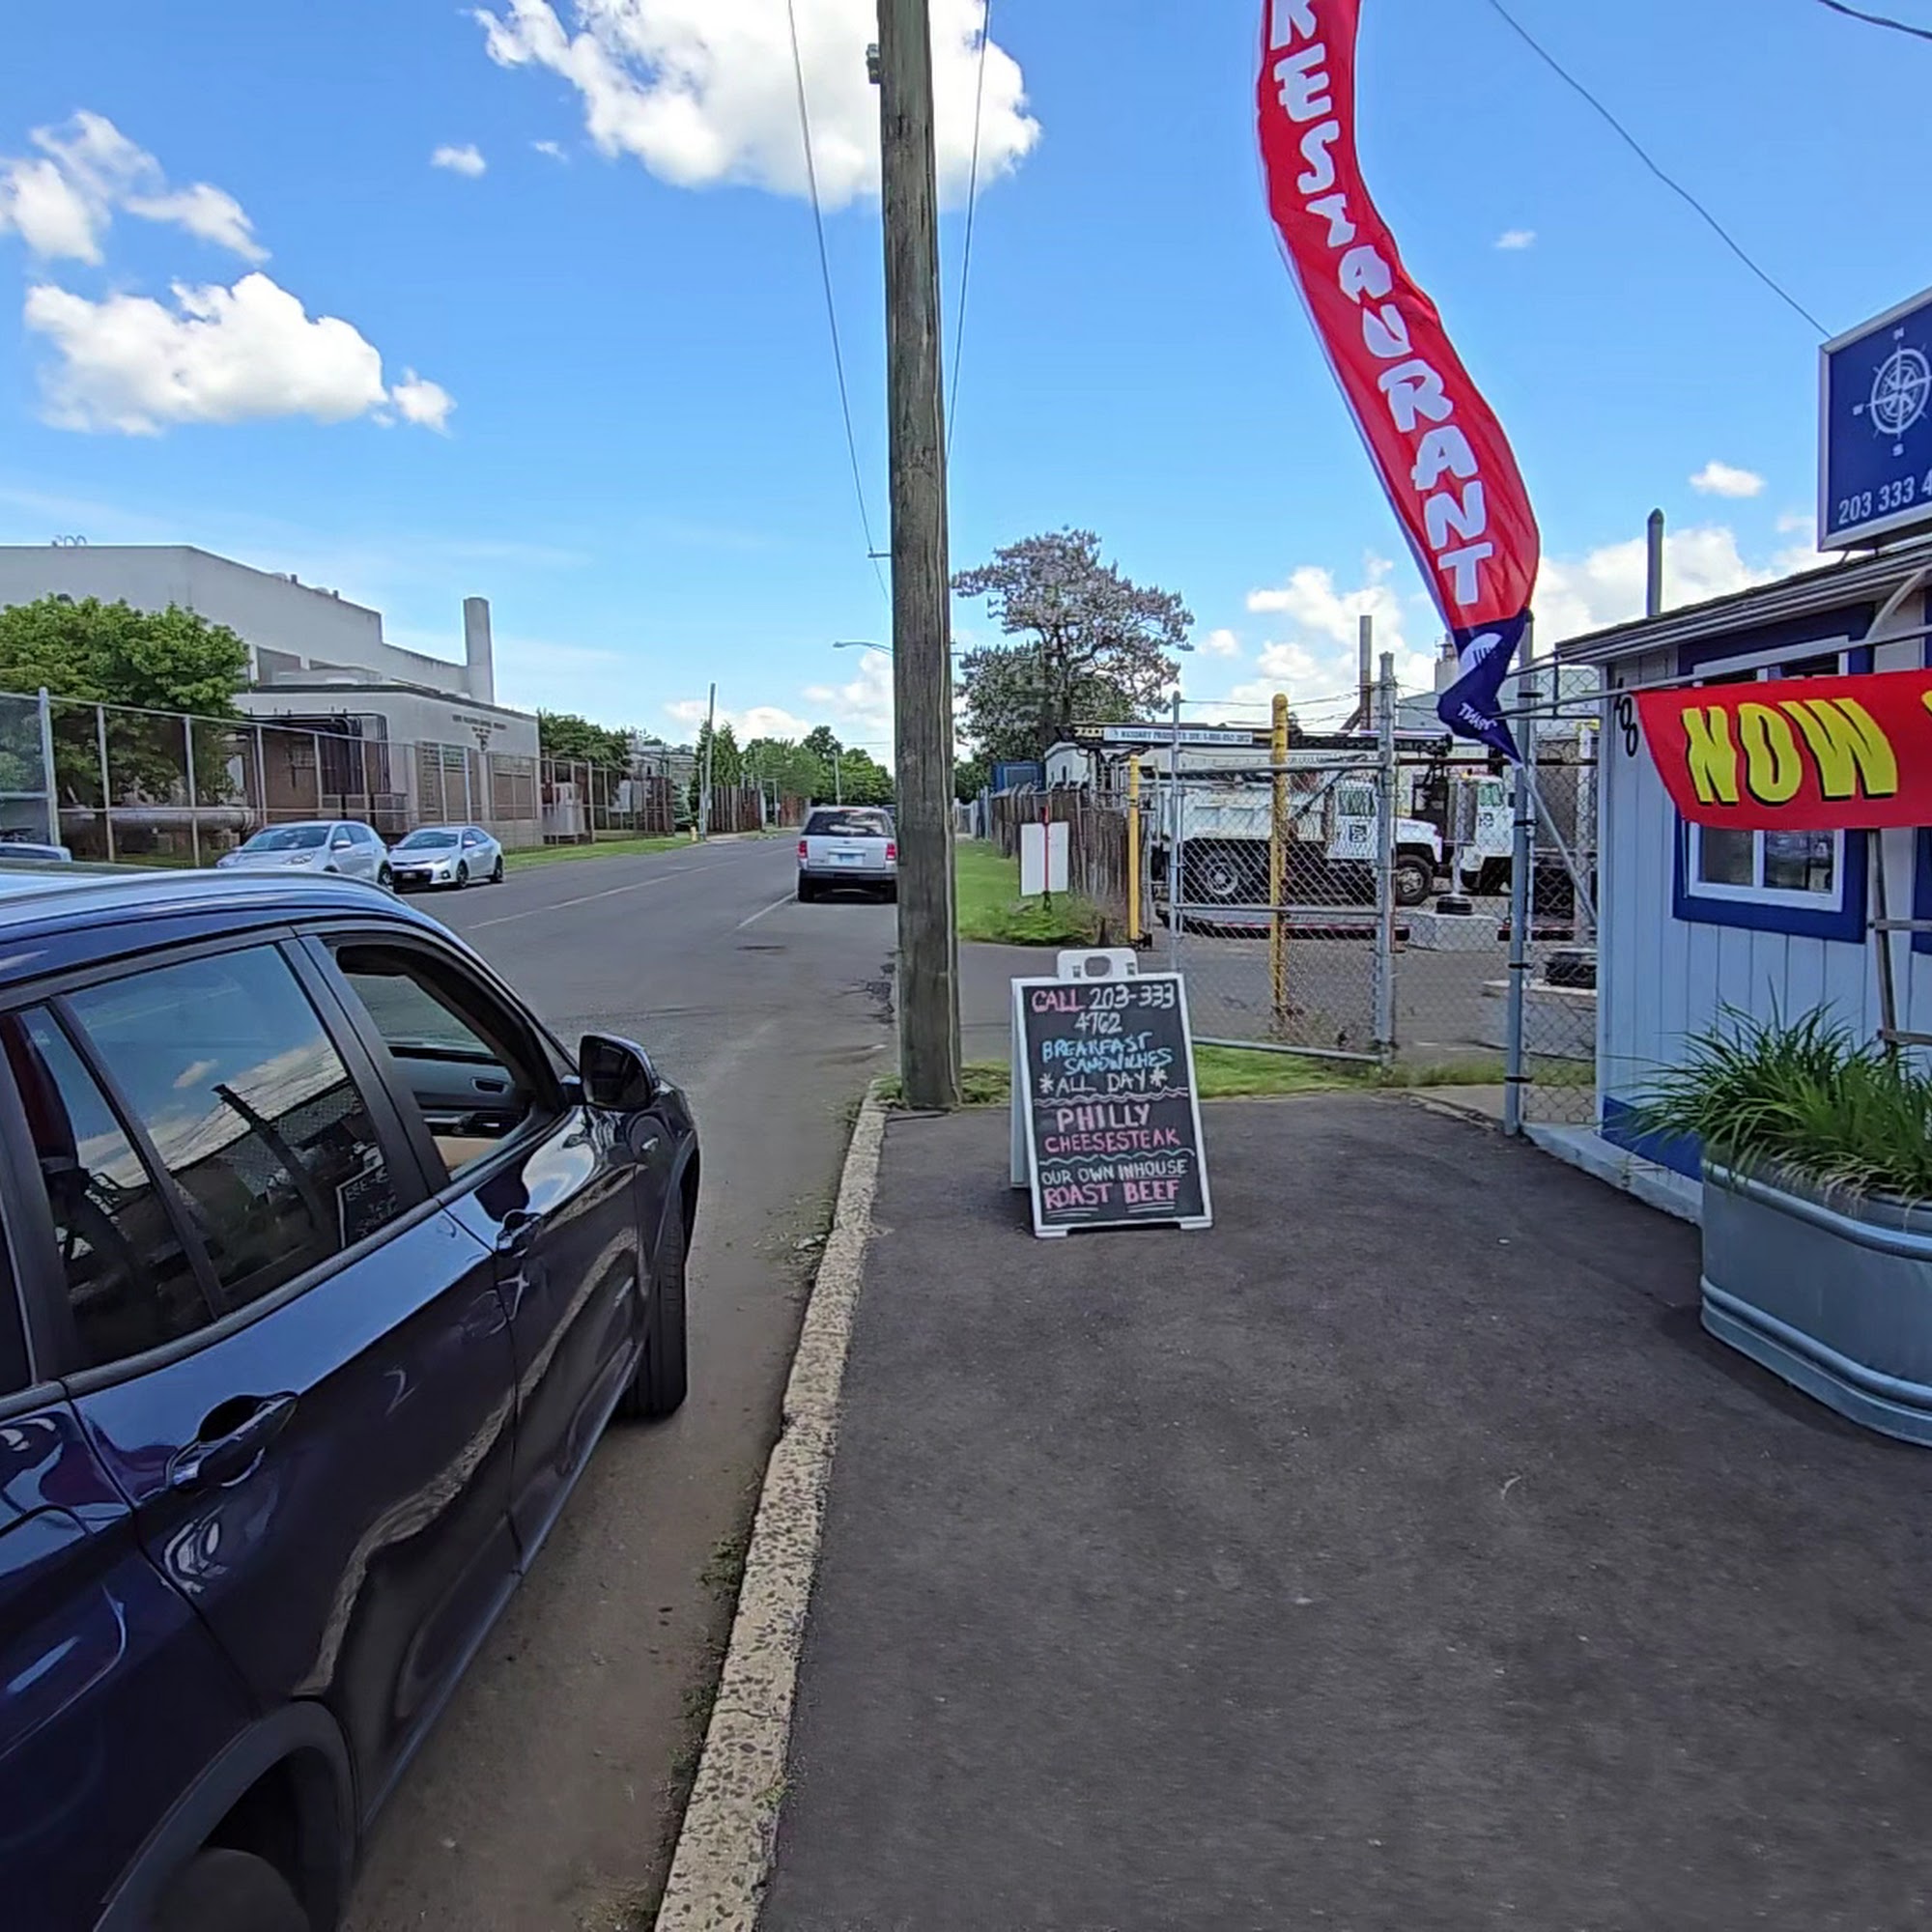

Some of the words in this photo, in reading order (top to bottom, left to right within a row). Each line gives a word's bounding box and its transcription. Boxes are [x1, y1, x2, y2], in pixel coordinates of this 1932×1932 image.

[1270, 0, 1494, 606] RESTAURANT
[1838, 491, 1872, 525] 203
[1879, 476, 1915, 512] 333
[1682, 696, 1898, 806] NOW
[1032, 988, 1086, 1012] CALL
[1089, 983, 1175, 1009] 203-333
[1074, 1011, 1122, 1035] 4762
[1042, 1032, 1152, 1063] BREAKFAST
[1065, 1047, 1173, 1076] SANDWICHES
[1057, 1103, 1150, 1133] PHILLY
[1044, 1127, 1180, 1152] CHEESESTEAK
[1041, 1169, 1072, 1185] OUR
[1078, 1164, 1114, 1183] OWN
[1118, 1159, 1188, 1180] INHOUSE
[1043, 1182, 1112, 1209] ROAST
[1123, 1179, 1179, 1205] BEEF
